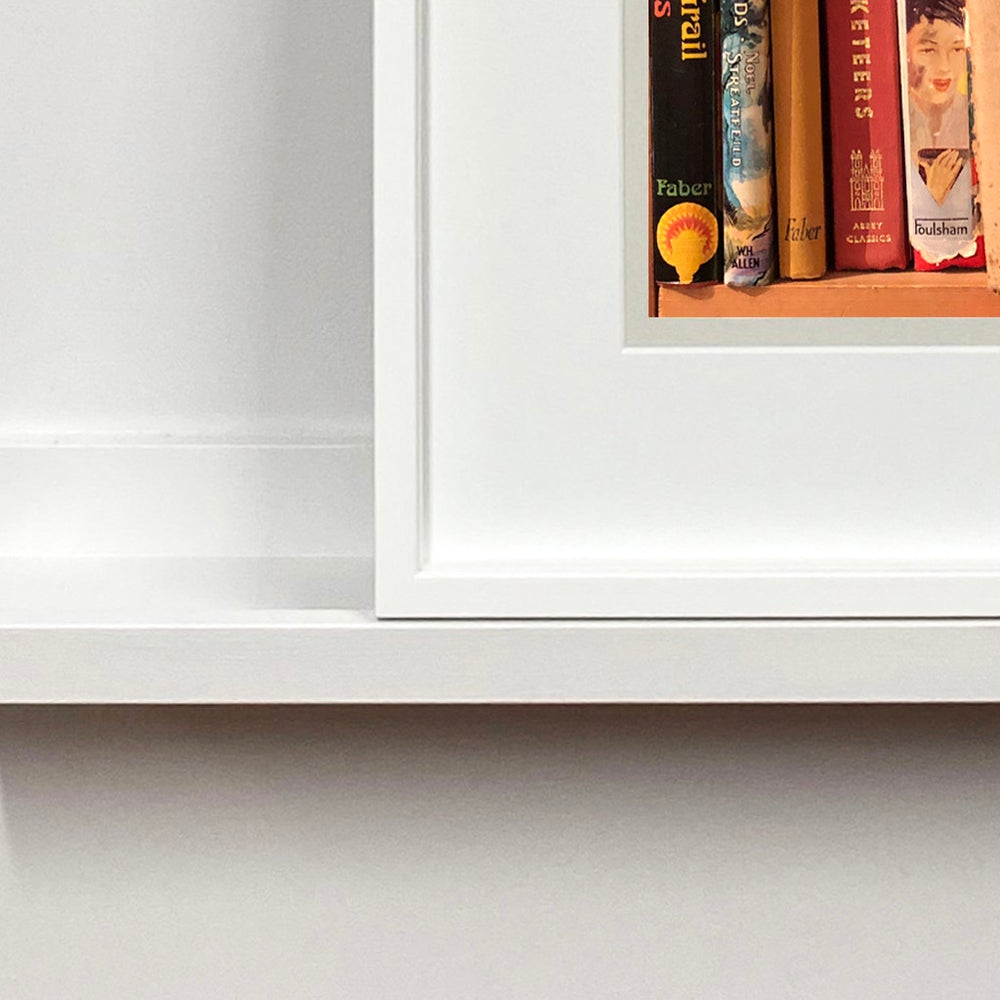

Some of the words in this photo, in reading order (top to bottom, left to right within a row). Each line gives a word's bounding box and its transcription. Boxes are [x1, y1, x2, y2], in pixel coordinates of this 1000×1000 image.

[656, 179, 712, 197] Faber
[784, 217, 822, 243] Faber
[913, 218, 968, 237] Foulsham
[731, 257, 760, 269] ALLEN
